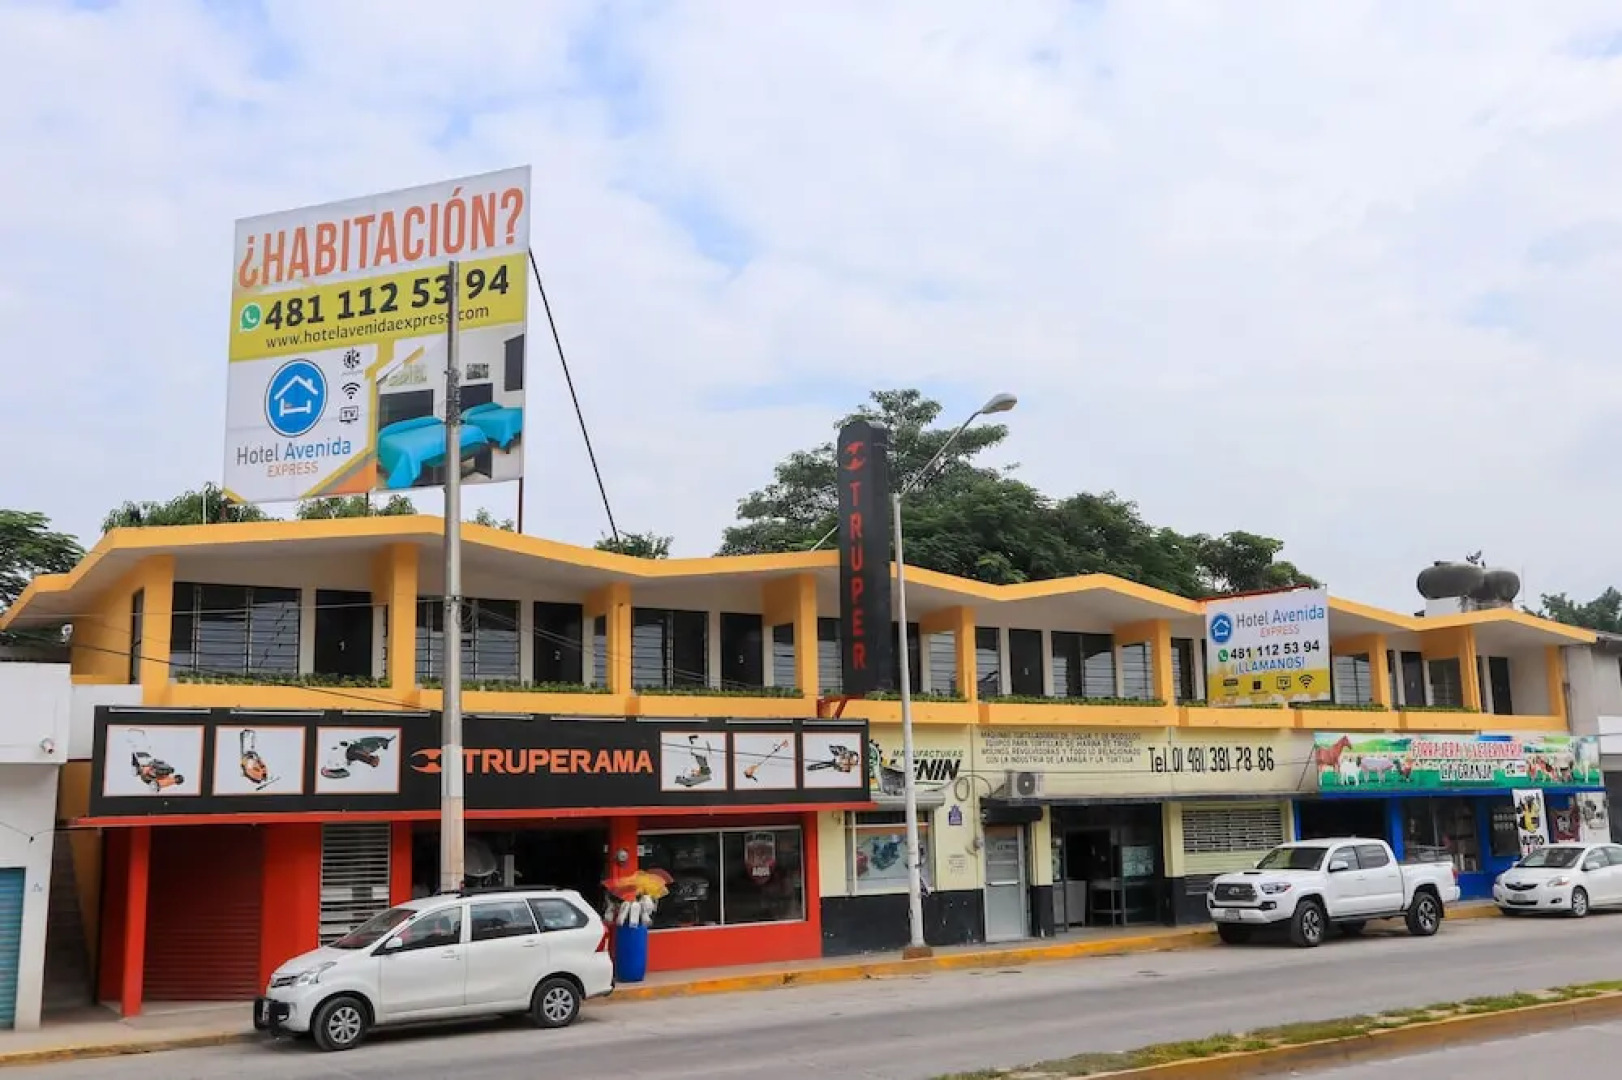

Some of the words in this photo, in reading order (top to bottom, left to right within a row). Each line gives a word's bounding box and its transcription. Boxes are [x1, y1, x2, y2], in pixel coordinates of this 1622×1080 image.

[238, 186, 524, 288] ¿HABITACIÓN?
[265, 294, 325, 331] 481
[336, 281, 399, 321] 112
[410, 272, 450, 309] 53
[465, 263, 510, 300] 94
[236, 446, 280, 466] Hotel
[283, 436, 352, 461] Avenida
[266, 461, 319, 478] EXPRESS
[849, 480, 867, 671] TRUPER
[1236, 611, 1269, 628] Hotel
[1272, 605, 1325, 623] Avenida
[1260, 624, 1300, 637] EXPRESS
[1230, 647, 1252, 660] 481
[1256, 643, 1279, 658] 112
[1283, 641, 1300, 655] 53
[1303, 639, 1321, 653] 94
[463, 748, 654, 774] TRUPERAMA
[1209, 746, 1231, 773] 381
[1235, 746, 1252, 772] 78
[1257, 746, 1275, 772] 86
